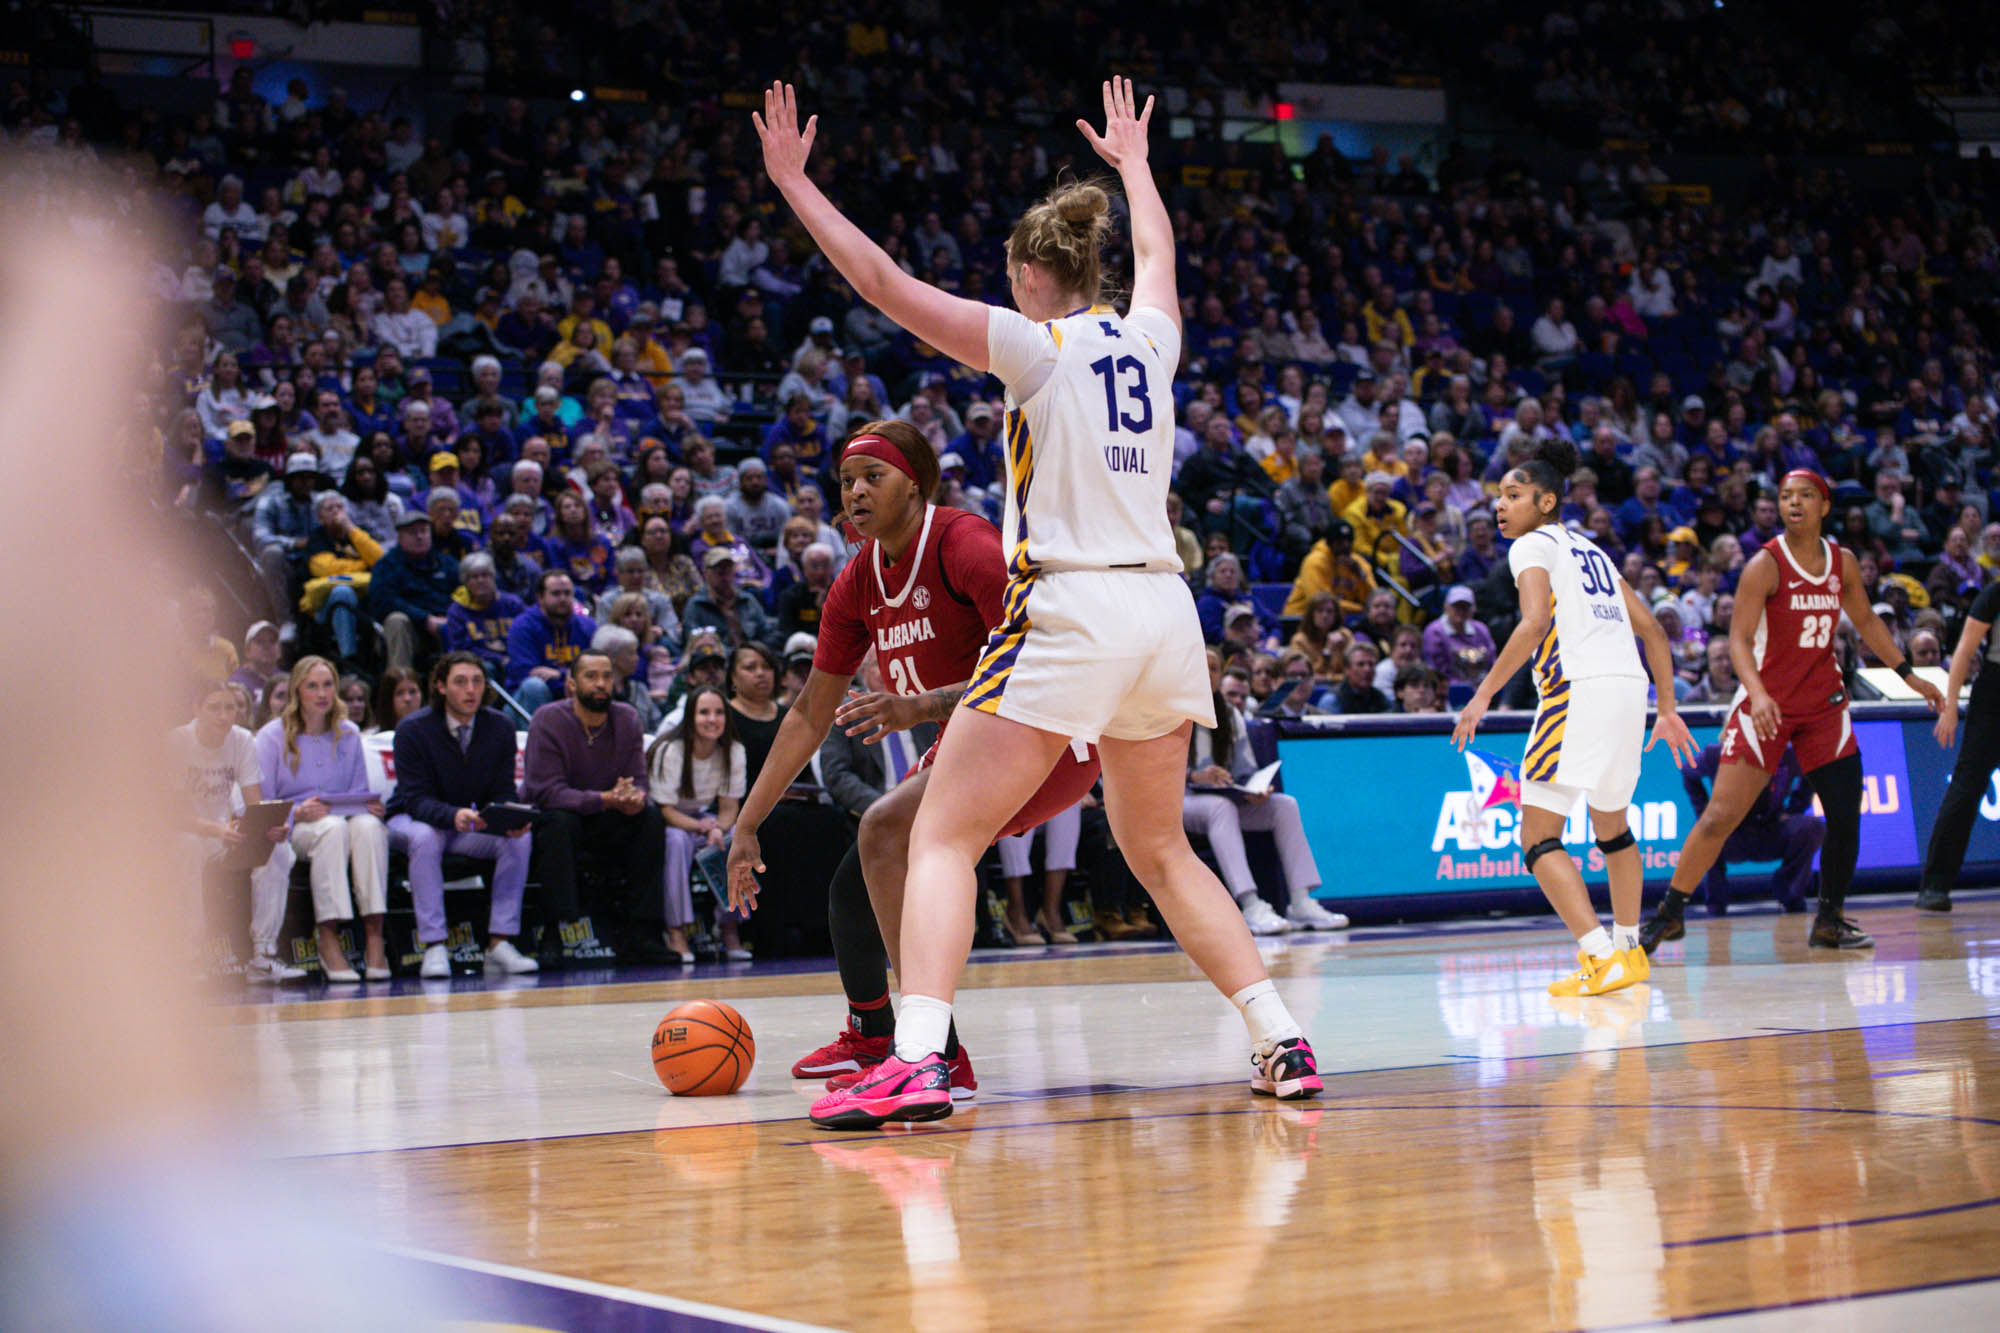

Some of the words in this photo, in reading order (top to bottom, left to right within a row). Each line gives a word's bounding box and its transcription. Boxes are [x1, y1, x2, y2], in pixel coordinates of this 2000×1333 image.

[1090, 354, 1153, 434] 13
[1104, 445, 1149, 474] KOVAL
[1571, 547, 1616, 597] 30
[1789, 593, 1840, 611] ALABAMA
[1798, 614, 1833, 649] 23
[888, 655, 929, 698] 21
[1436, 852, 1583, 881] Ambule
[1587, 846, 1681, 872] Sice
